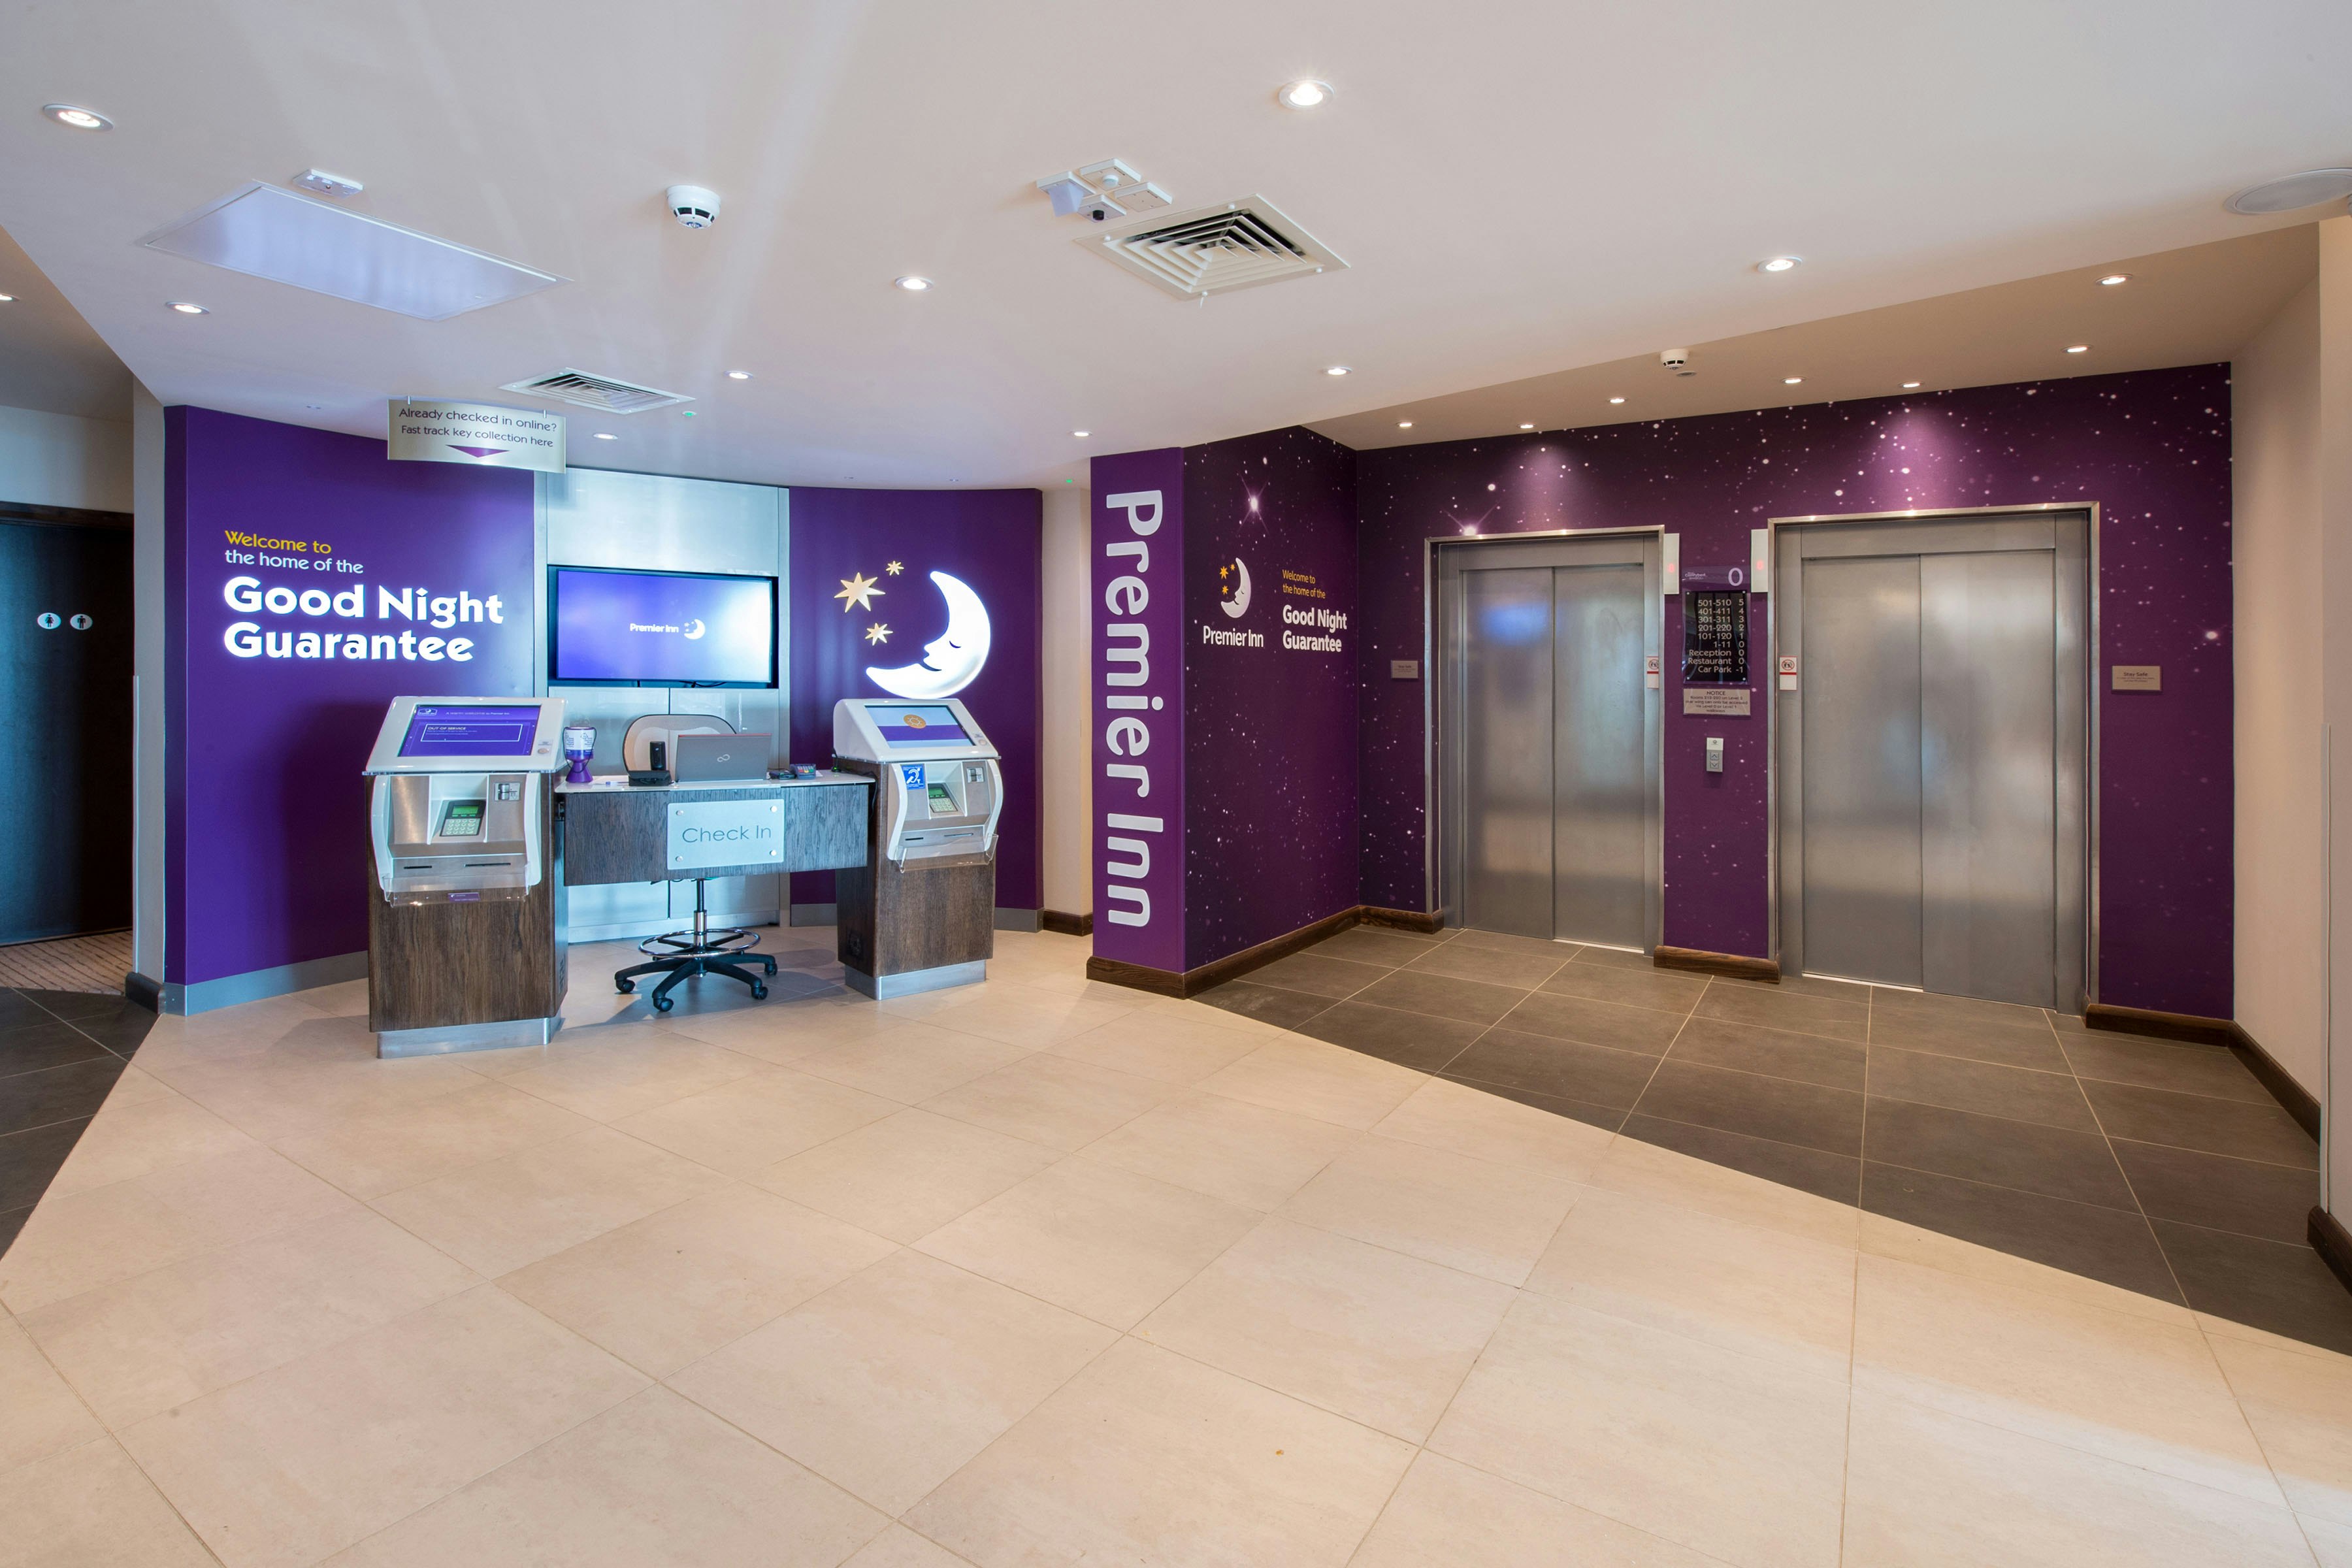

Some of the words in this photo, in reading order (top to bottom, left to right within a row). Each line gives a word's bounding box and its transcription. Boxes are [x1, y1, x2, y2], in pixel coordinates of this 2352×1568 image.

[399, 408, 443, 421] Already
[446, 410, 498, 423] checked
[502, 416, 512, 425] in
[516, 419, 557, 432] online?
[401, 425, 421, 434] Fast
[424, 426, 449, 436] track
[453, 427, 472, 438] key
[475, 431, 527, 444] collection
[531, 436, 553, 447] here
[225, 530, 307, 552] Welcome
[312, 540, 331, 554] to
[225, 549, 255, 565] the
[259, 552, 309, 570] home
[314, 558, 333, 571] of
[336, 559, 364, 574] the
[1282, 569, 1309, 583] Welcome
[1309, 574, 1316, 584] to
[1728, 567, 1743, 586] 0
[223, 576, 365, 618] Good
[378, 585, 504, 629] Night
[1282, 583, 1293, 594] the
[1293, 584, 1309, 596] home
[1310, 587, 1316, 598] of
[1316, 589, 1326, 599] the
[630, 623, 665, 632] Premier
[1282, 604, 1315, 626] Good
[1317, 609, 1347, 633] Night
[223, 621, 475, 662] Guarantee
[1105, 489, 1164, 798] Premier
[1203, 625, 1247, 647] Premier
[1248, 629, 1264, 647] Inn
[1282, 630, 1342, 652] Guarantee
[682, 826, 749, 843] Check
[756, 825, 772, 839] In
[1107, 813, 1164, 928] Inn
